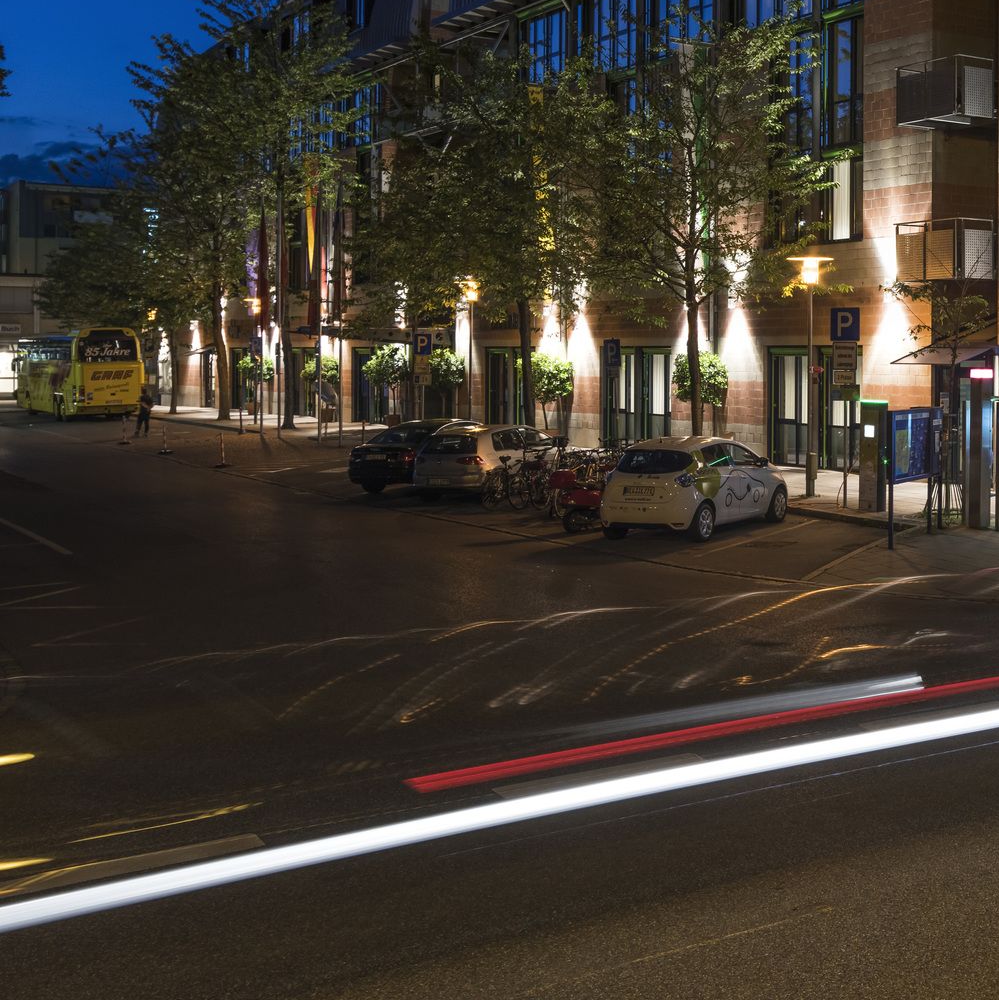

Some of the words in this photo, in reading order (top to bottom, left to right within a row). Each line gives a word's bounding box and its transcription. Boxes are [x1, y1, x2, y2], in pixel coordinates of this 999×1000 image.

[837, 311, 853, 337] P
[85, 347, 100, 357] 85
[418, 336, 428, 353] P
